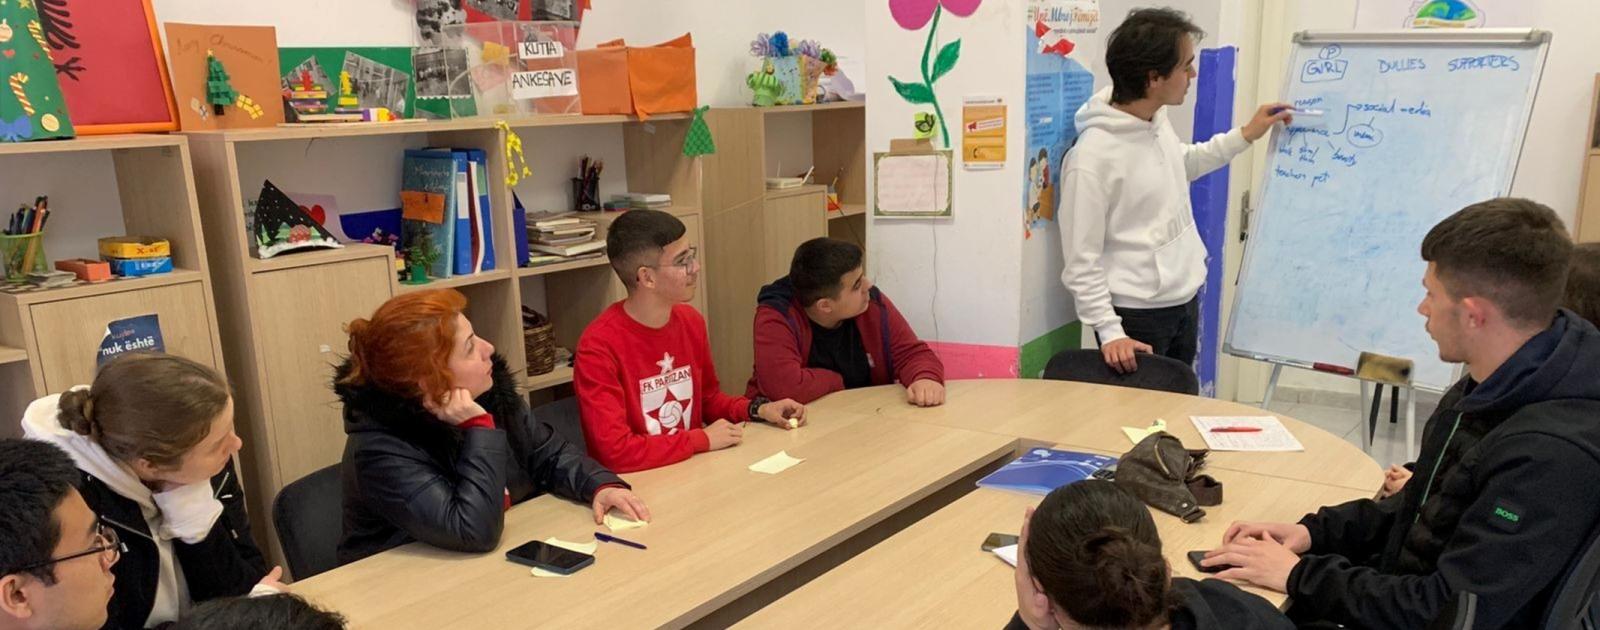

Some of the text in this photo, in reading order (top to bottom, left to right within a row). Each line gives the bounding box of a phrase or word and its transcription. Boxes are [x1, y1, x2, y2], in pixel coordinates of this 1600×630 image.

[524, 41, 557, 56] KUTIA
[1326, 47, 1337, 60] P
[512, 70, 572, 89] ANKESAVE
[1363, 98, 1396, 113] social
[102, 336, 155, 356] nuk është
[642, 382, 654, 392] FK
[1495, 507, 1519, 522] BOSS
